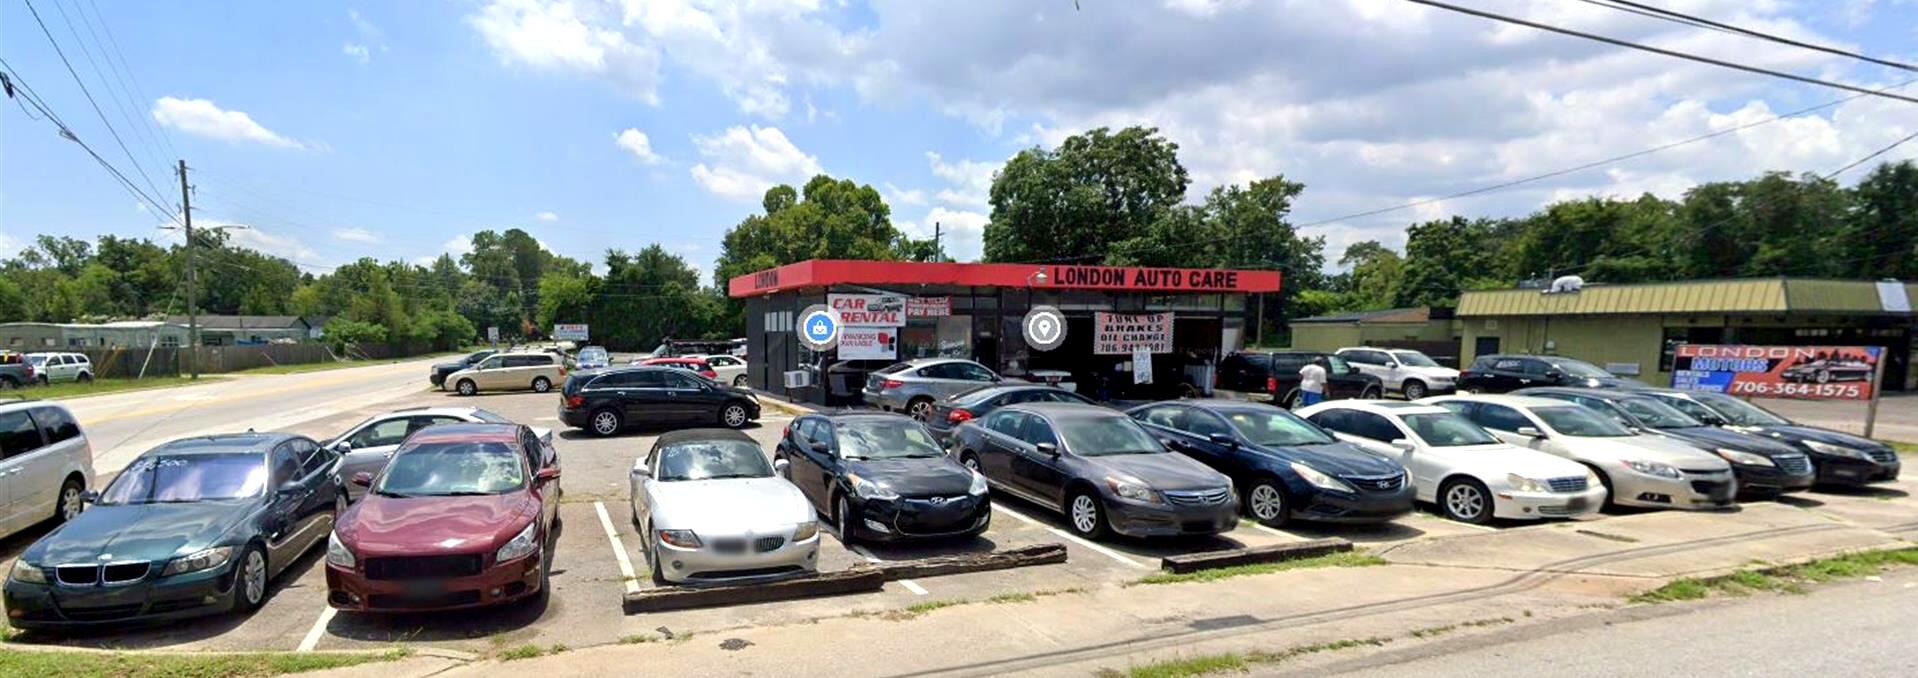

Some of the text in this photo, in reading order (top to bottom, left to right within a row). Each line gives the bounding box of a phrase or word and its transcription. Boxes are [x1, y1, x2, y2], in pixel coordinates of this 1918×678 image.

[1054, 267, 1237, 288] LONDON AUTO CARE
[833, 298, 865, 309] CAR
[841, 311, 899, 322] RENTAL
[1680, 346, 1815, 358] LONDON
[1690, 356, 1769, 372] MOTORS
[1734, 380, 1859, 397] 706-364-1575
